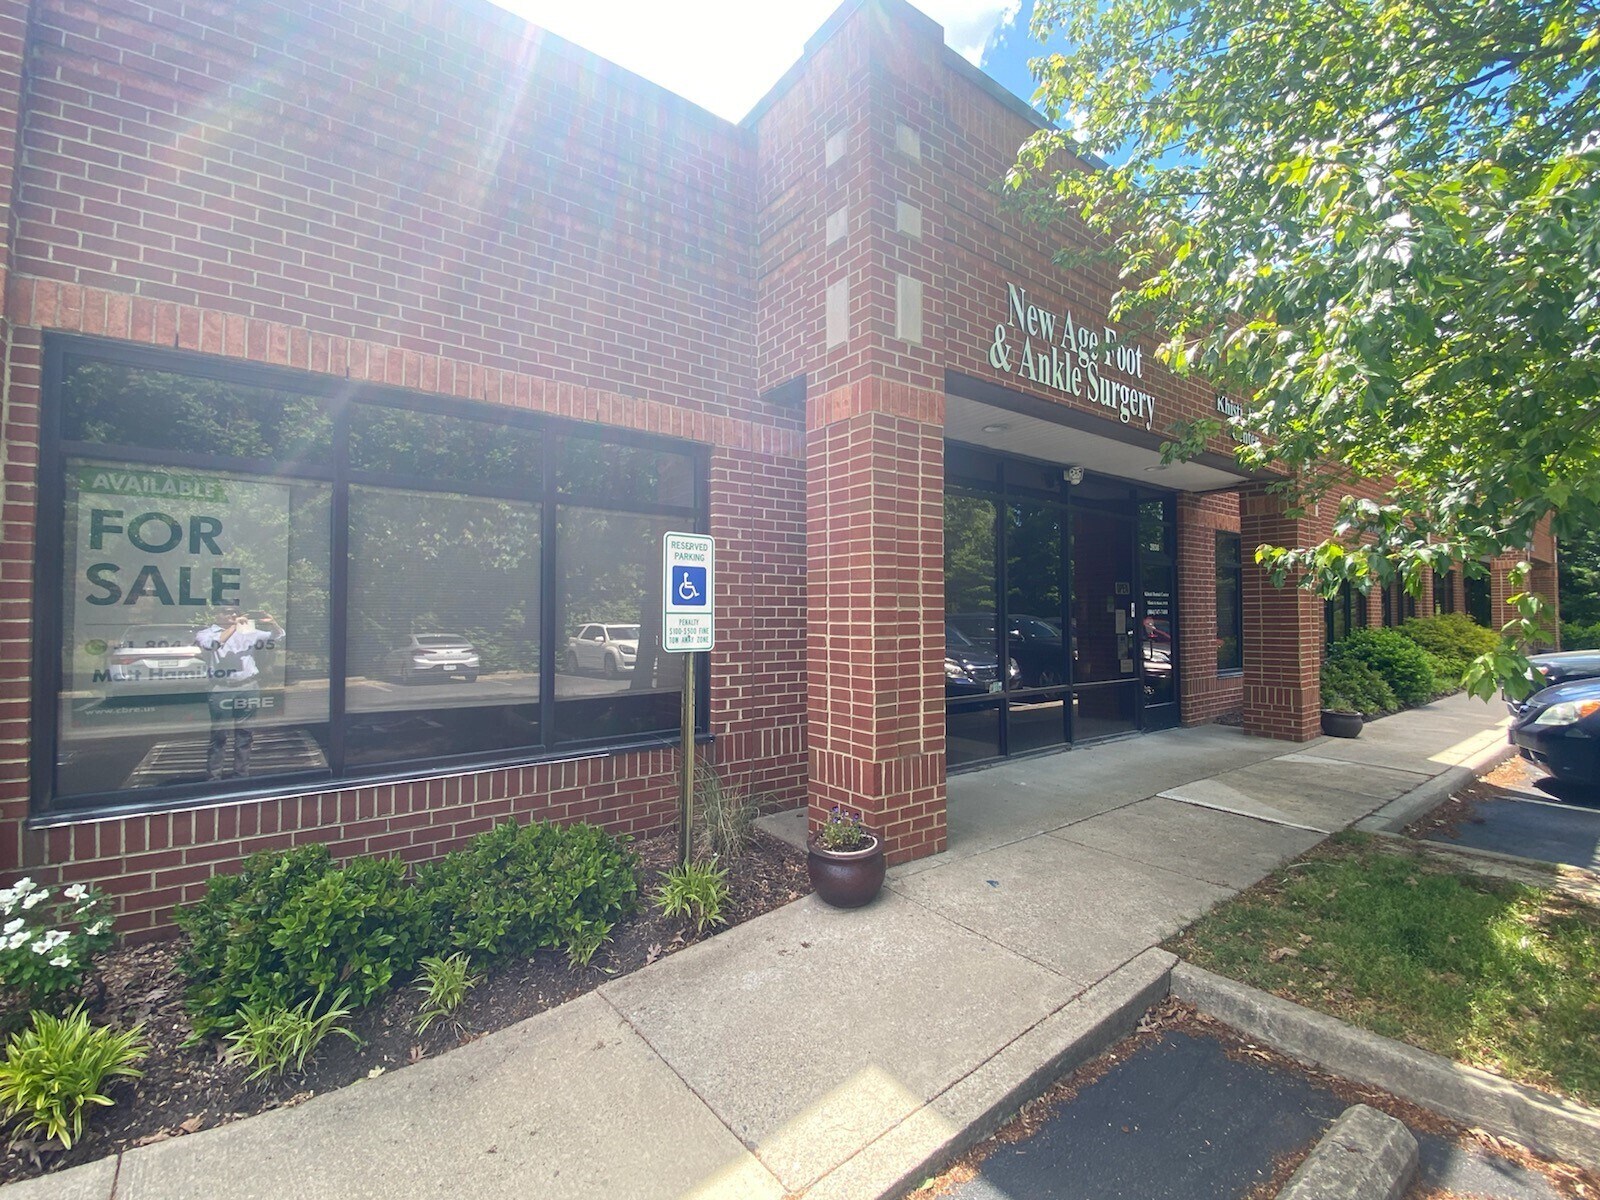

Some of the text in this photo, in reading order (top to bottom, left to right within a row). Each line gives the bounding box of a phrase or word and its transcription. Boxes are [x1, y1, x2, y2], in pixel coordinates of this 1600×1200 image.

[1006, 282, 1143, 379] New Age Foot
[989, 324, 1155, 431] & Ankle Surgery
[1217, 396, 1243, 417] Khisti
[92, 472, 217, 498] AVAILABLE
[89, 509, 224, 556] FOR
[671, 541, 709, 552] RESERVED
[674, 552, 705, 562] PARKING
[85, 562, 241, 606] SALE
[679, 618, 700, 626] PENALTY
[698, 627, 709, 635] FINE
[669, 636, 679, 644] TOW
[92, 668, 142, 683] Matt
[84, 706, 156, 716] www.cbre.us
[218, 696, 275, 711] CBRE
